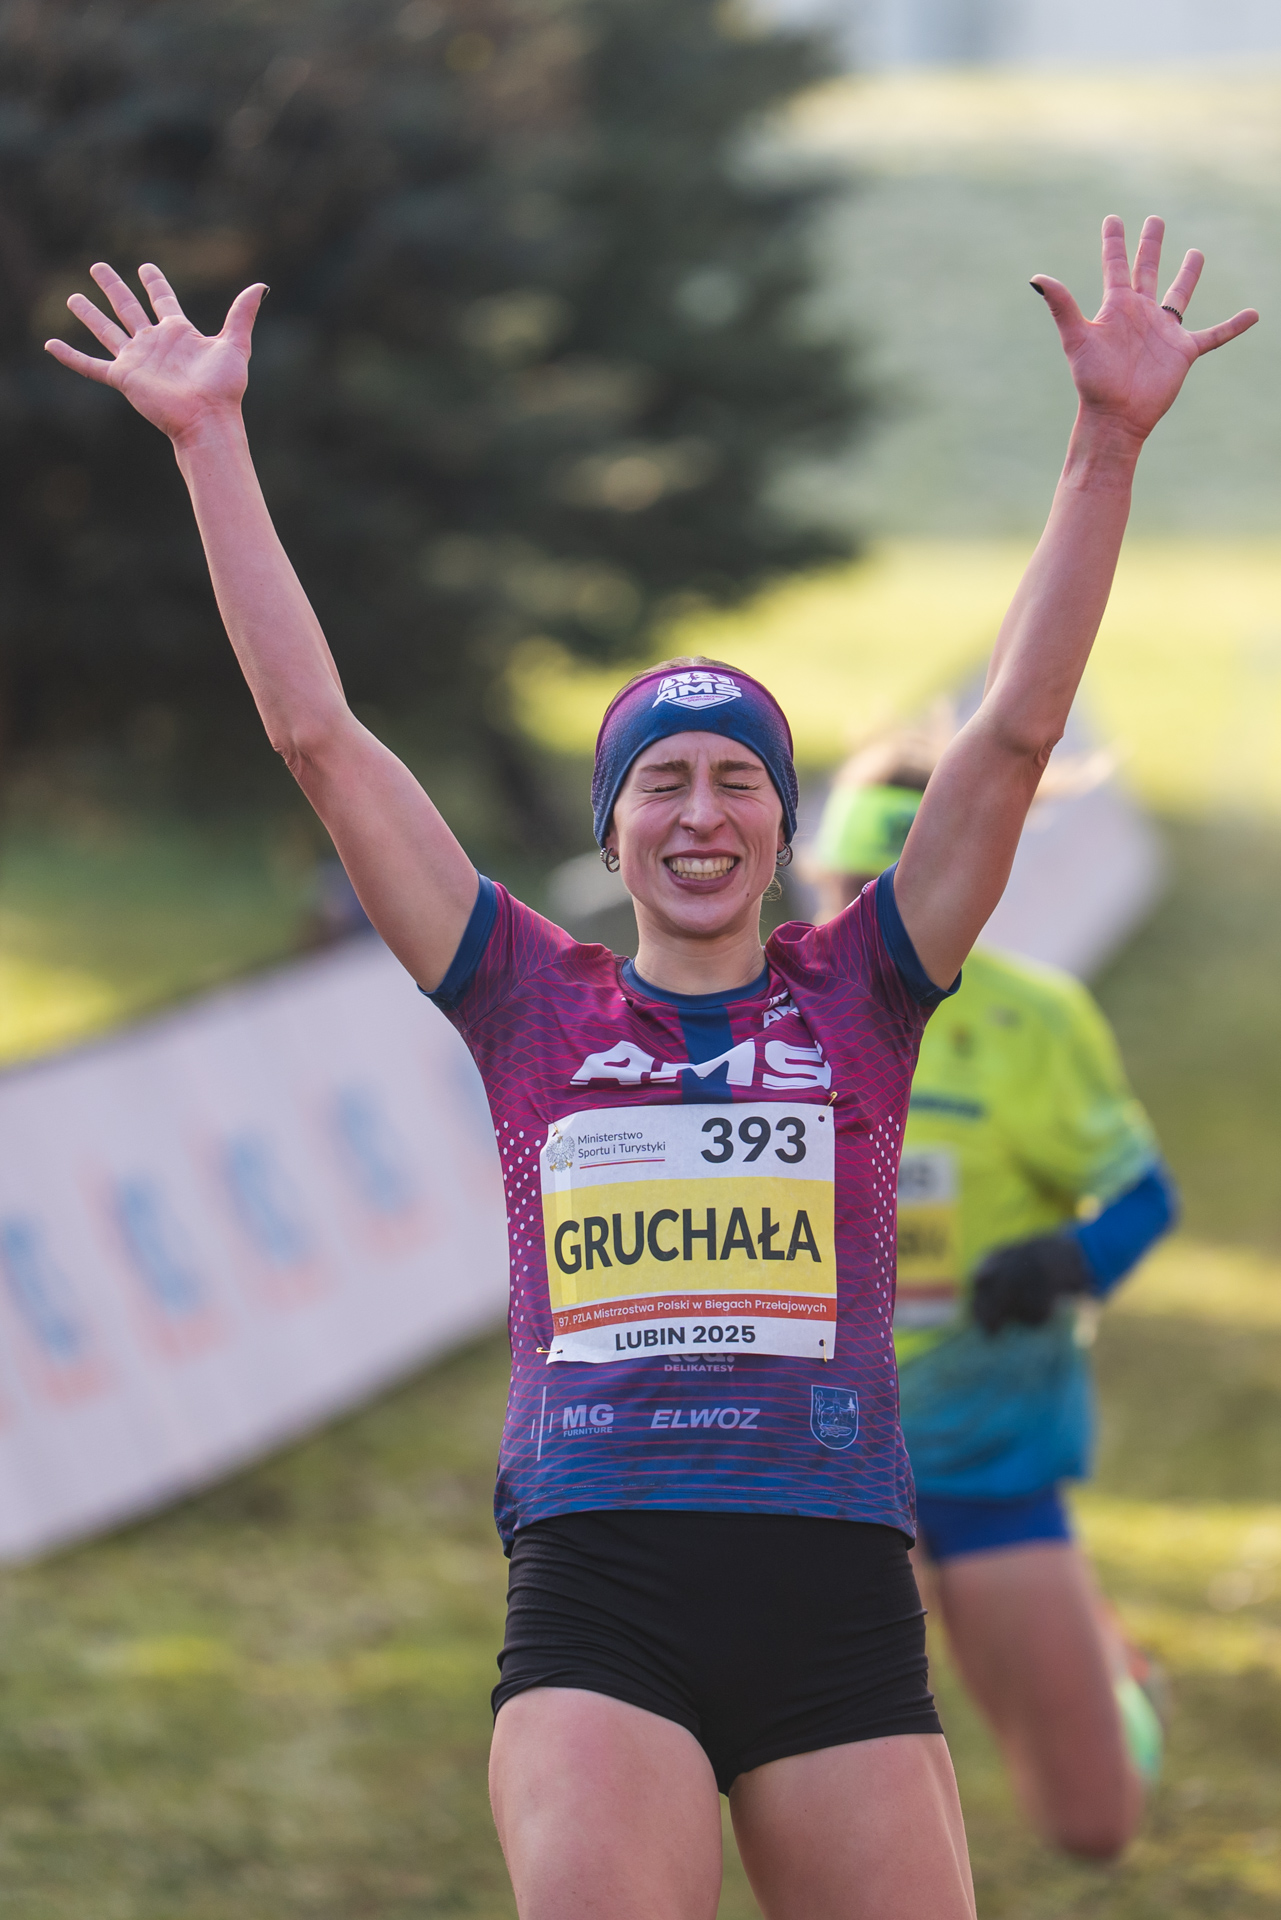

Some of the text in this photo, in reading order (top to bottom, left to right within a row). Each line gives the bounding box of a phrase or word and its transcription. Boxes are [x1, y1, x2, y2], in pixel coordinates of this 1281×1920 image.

[652, 682, 742, 708] AMS
[569, 1038, 832, 1090] AMS
[577, 1131, 643, 1145] Ministerstwo
[578, 1141, 666, 1159] Sportu i Turystyki
[700, 1116, 807, 1164] 393
[554, 1207, 822, 1275] GRUCHAŁA
[558, 1315, 572, 1327] 97.
[572, 1312, 592, 1324] PZLA
[593, 1303, 655, 1320] Mistrzostwa
[657, 1300, 690, 1311] Polski
[705, 1299, 752, 1311] Biegach
[755, 1300, 827, 1315] Przełajowych
[615, 1325, 756, 1351] LUBIN 2025
[664, 1364, 735, 1373] DELIKATESY
[562, 1403, 614, 1430] MG
[650, 1407, 761, 1430] ELWOZ
[563, 1426, 613, 1438] FURNITURE
